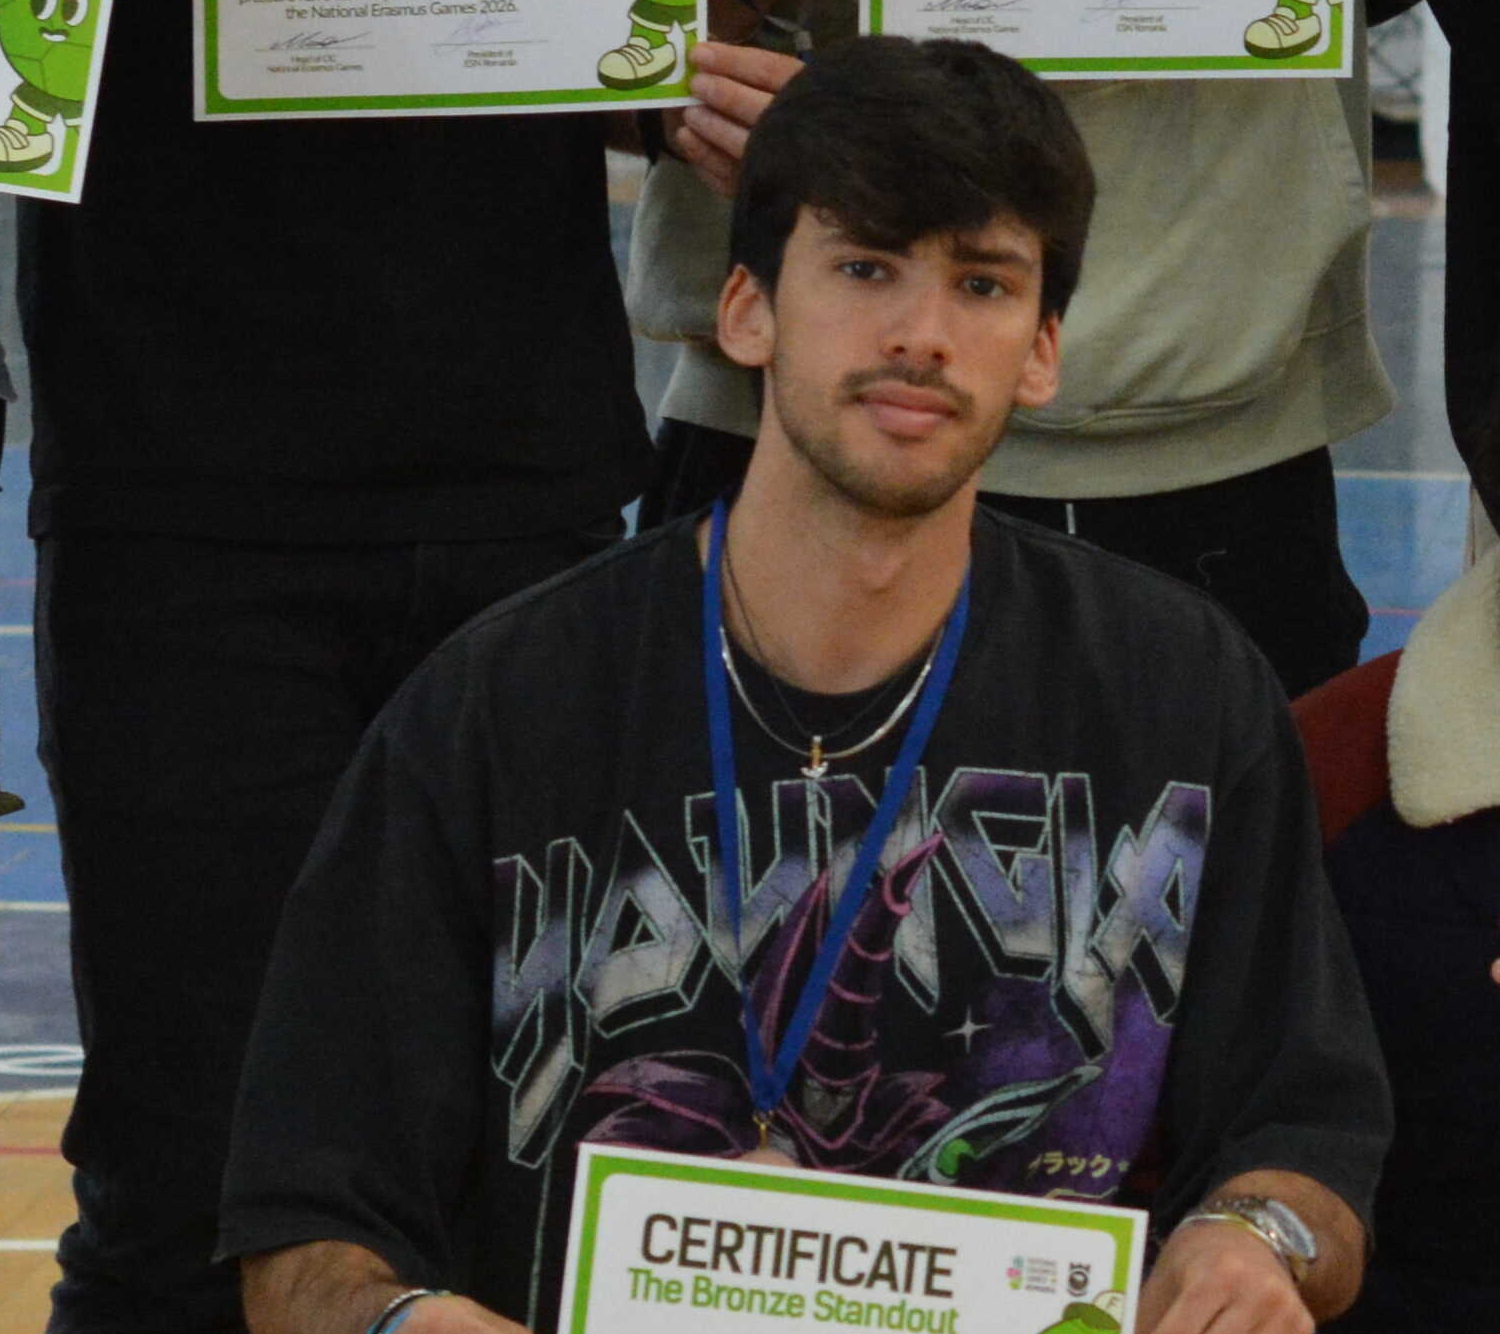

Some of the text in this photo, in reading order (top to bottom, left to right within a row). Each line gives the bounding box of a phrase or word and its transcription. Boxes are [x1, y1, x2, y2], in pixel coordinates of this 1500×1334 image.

[284, 5, 309, 20] the
[309, 4, 369, 19] National
[369, 2, 427, 18] Erasmus
[428, 0, 478, 16] Games
[641, 1214, 956, 1297] CERTIFICATE
[627, 1266, 685, 1304] The
[690, 1274, 806, 1318] Bronze
